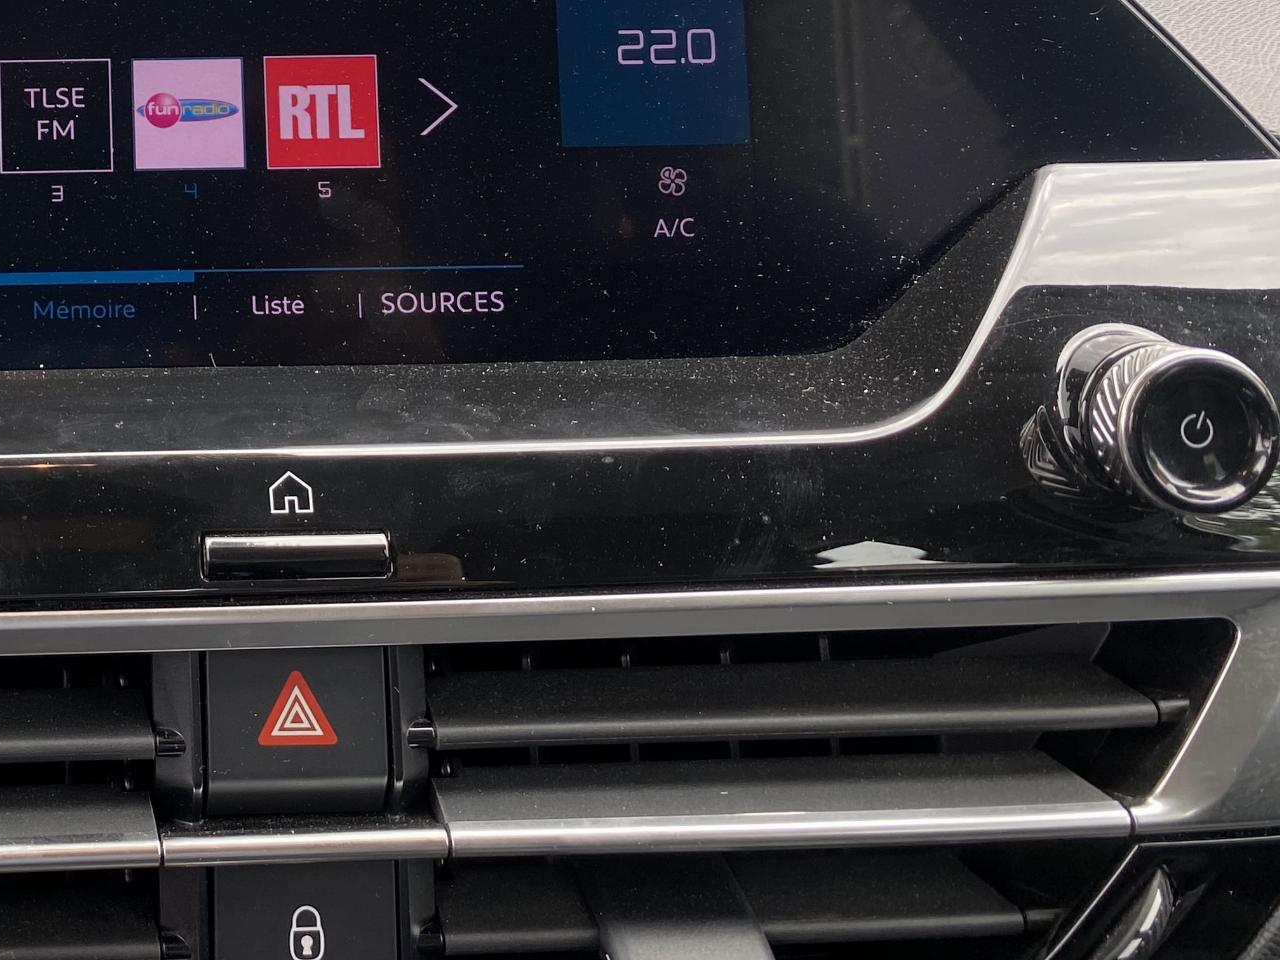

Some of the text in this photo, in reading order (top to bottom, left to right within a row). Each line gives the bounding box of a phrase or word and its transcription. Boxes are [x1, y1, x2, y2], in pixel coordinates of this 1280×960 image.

[616, 28, 717, 65] 22.0
[24, 87, 86, 109] TLSE
[278, 84, 366, 140] RTL
[36, 119, 76, 140] FM
[51, 185, 65, 203] 3
[183, 183, 198, 200] 4
[317, 180, 332, 199] 5
[654, 217, 696, 239] A/C
[33, 300, 137, 320] Mémoire
[251, 295, 305, 315] Liste
[380, 290, 506, 315] SOURCES
